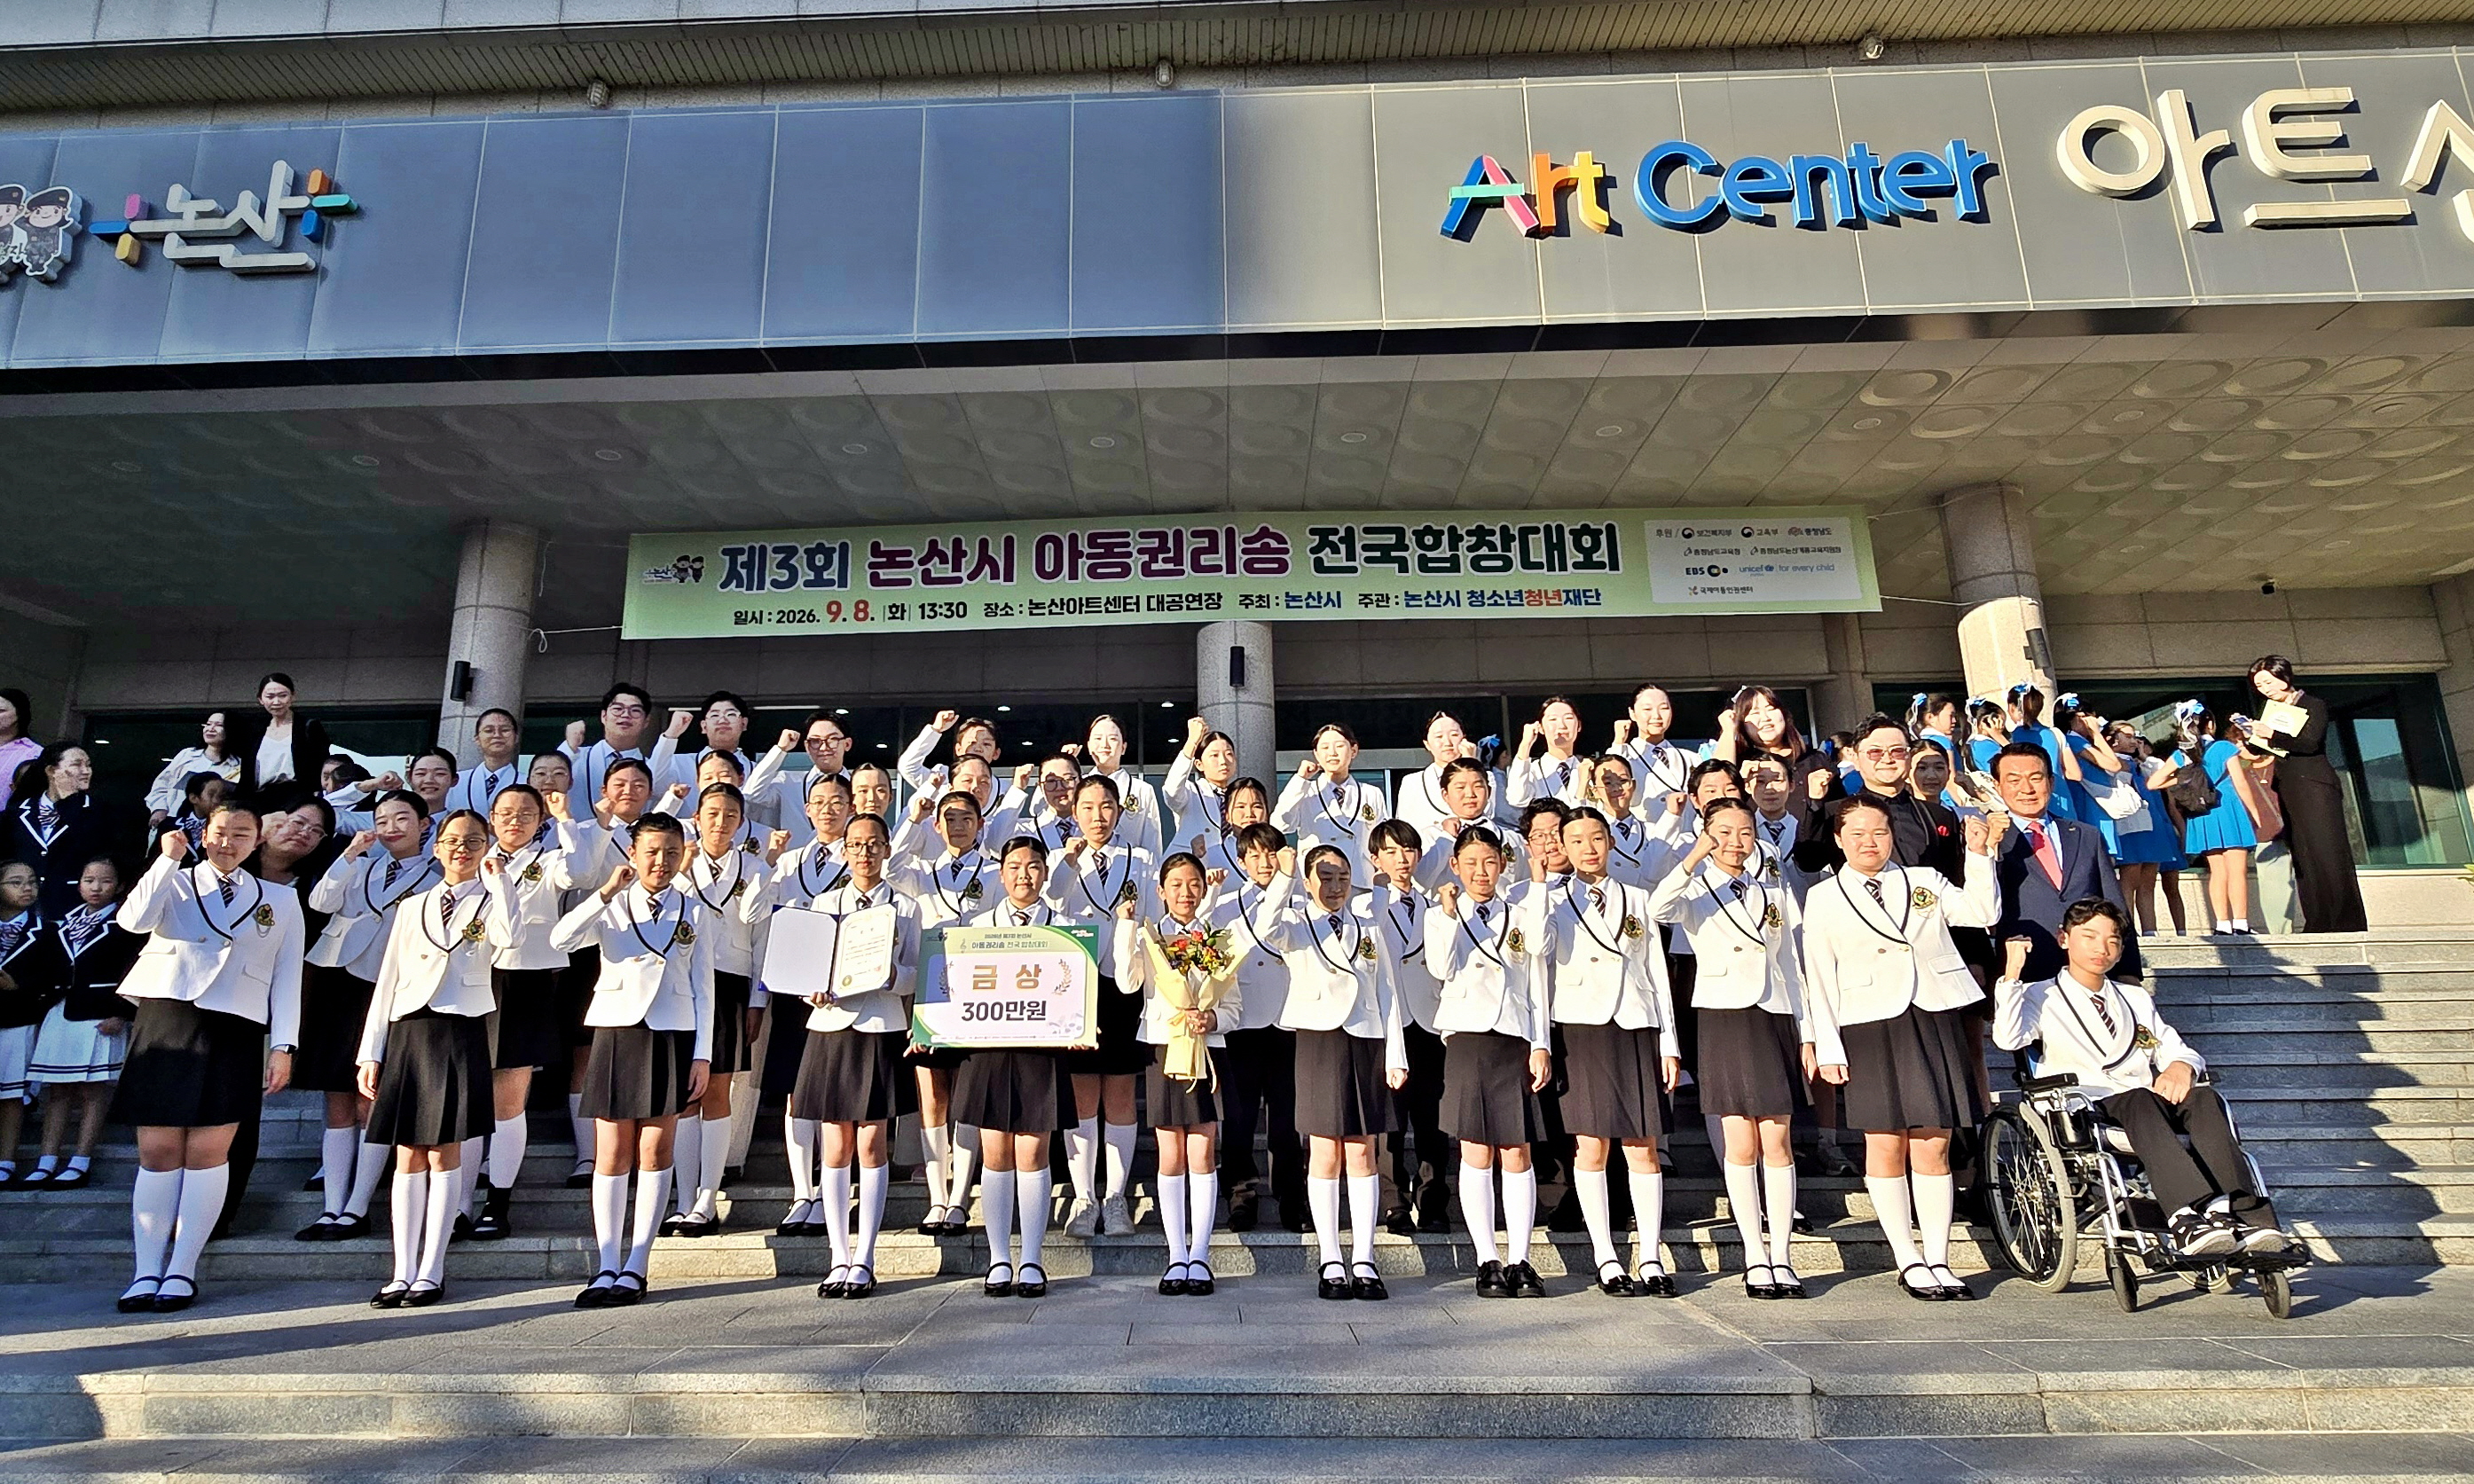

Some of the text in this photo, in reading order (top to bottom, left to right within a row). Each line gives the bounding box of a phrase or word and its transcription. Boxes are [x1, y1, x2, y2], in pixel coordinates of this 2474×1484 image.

[1441, 138, 1989, 238] Art Center
[129, 160, 317, 273] 논산
[719, 522, 1621, 592] 제3회 논산시 아동권리송 전국합창대회
[1685, 567, 1705, 576] EBS
[1739, 564, 1763, 573] unicef
[1791, 564, 1815, 573] every
[776, 609, 821, 624] 2026.
[918, 601, 968, 620] 13:30
[1027, 595, 1141, 617] 논산아트센터
[1146, 592, 1223, 613] 대공연장
[1284, 591, 1342, 609] 논산시
[1403, 590, 1461, 609] 논산시
[1466, 588, 1602, 608] 청소년청년재단
[961, 1000, 1047, 1022] 300만원
